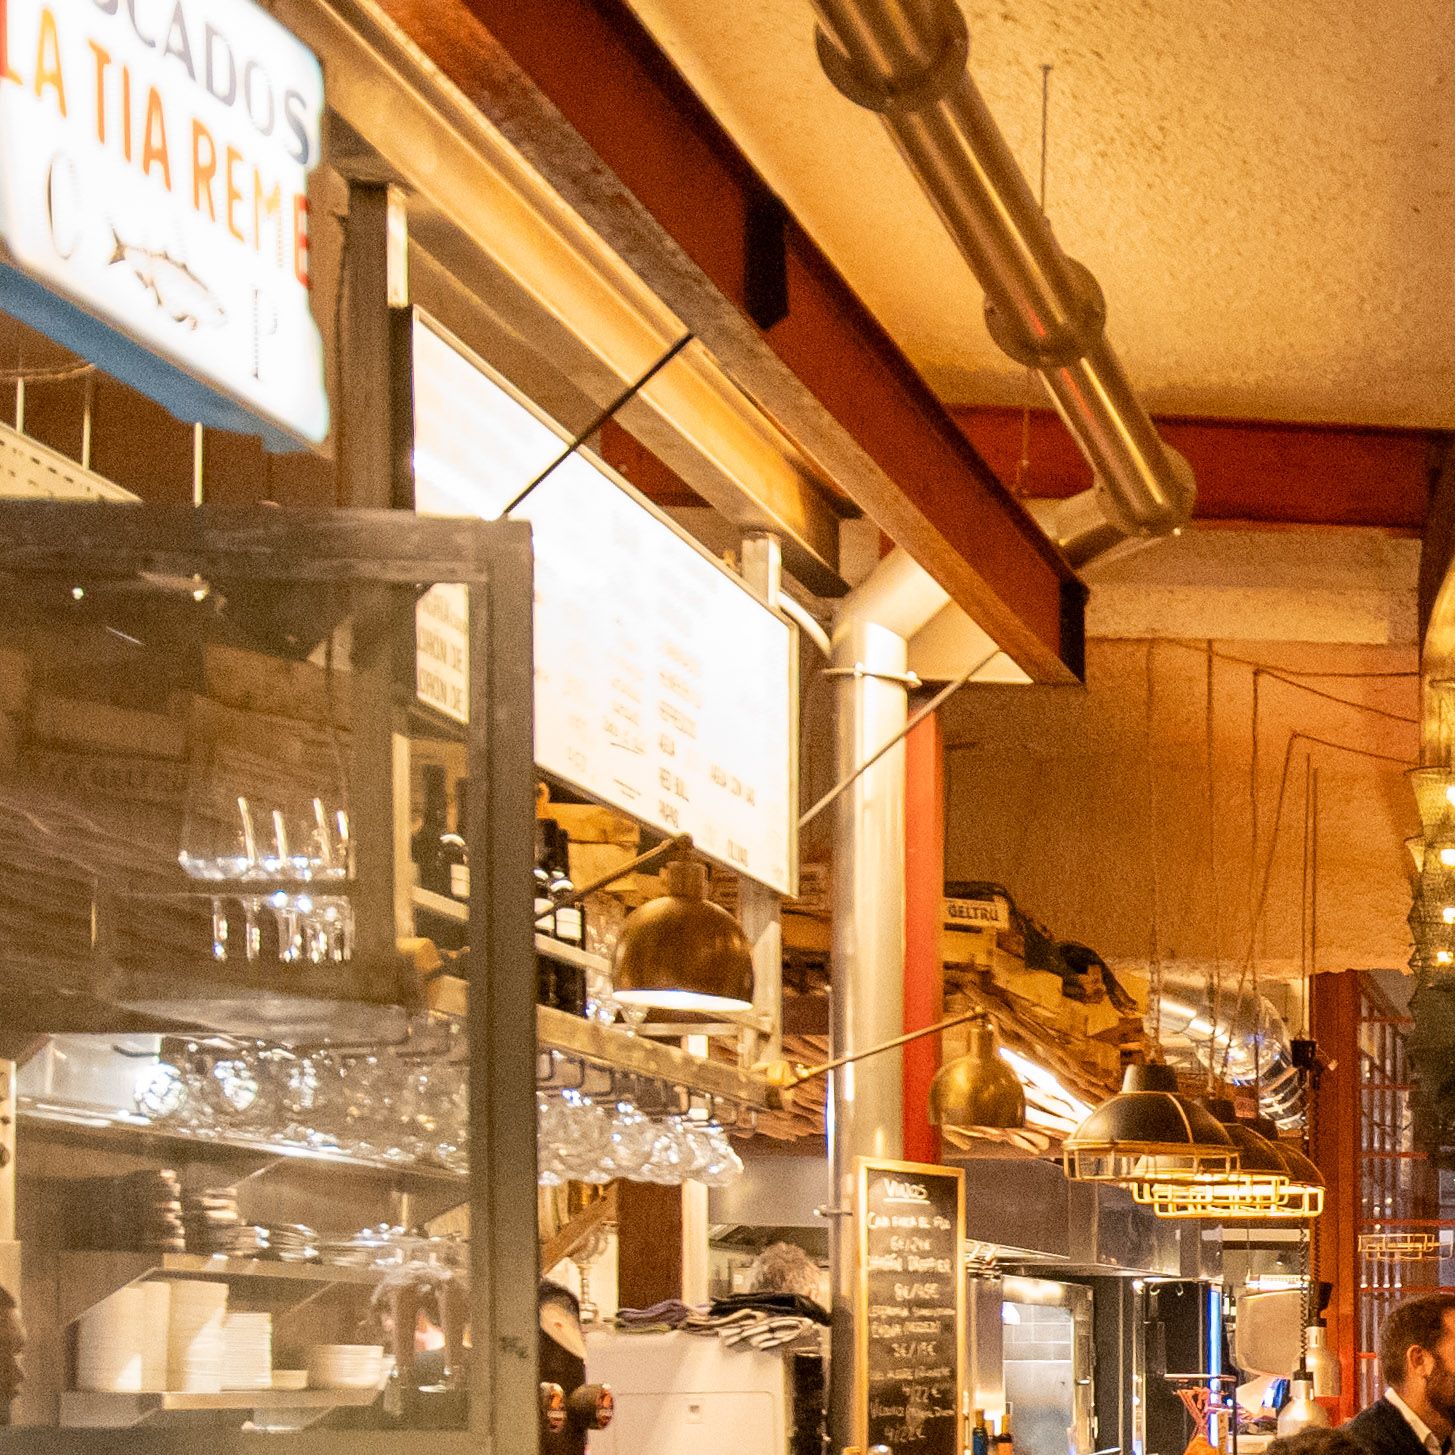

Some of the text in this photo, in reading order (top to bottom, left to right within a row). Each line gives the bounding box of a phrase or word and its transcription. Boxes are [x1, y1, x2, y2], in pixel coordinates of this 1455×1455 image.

[0, 0, 68, 119] LA
[87, 37, 172, 193] TIA
[93, 0, 312, 165] CADOS
